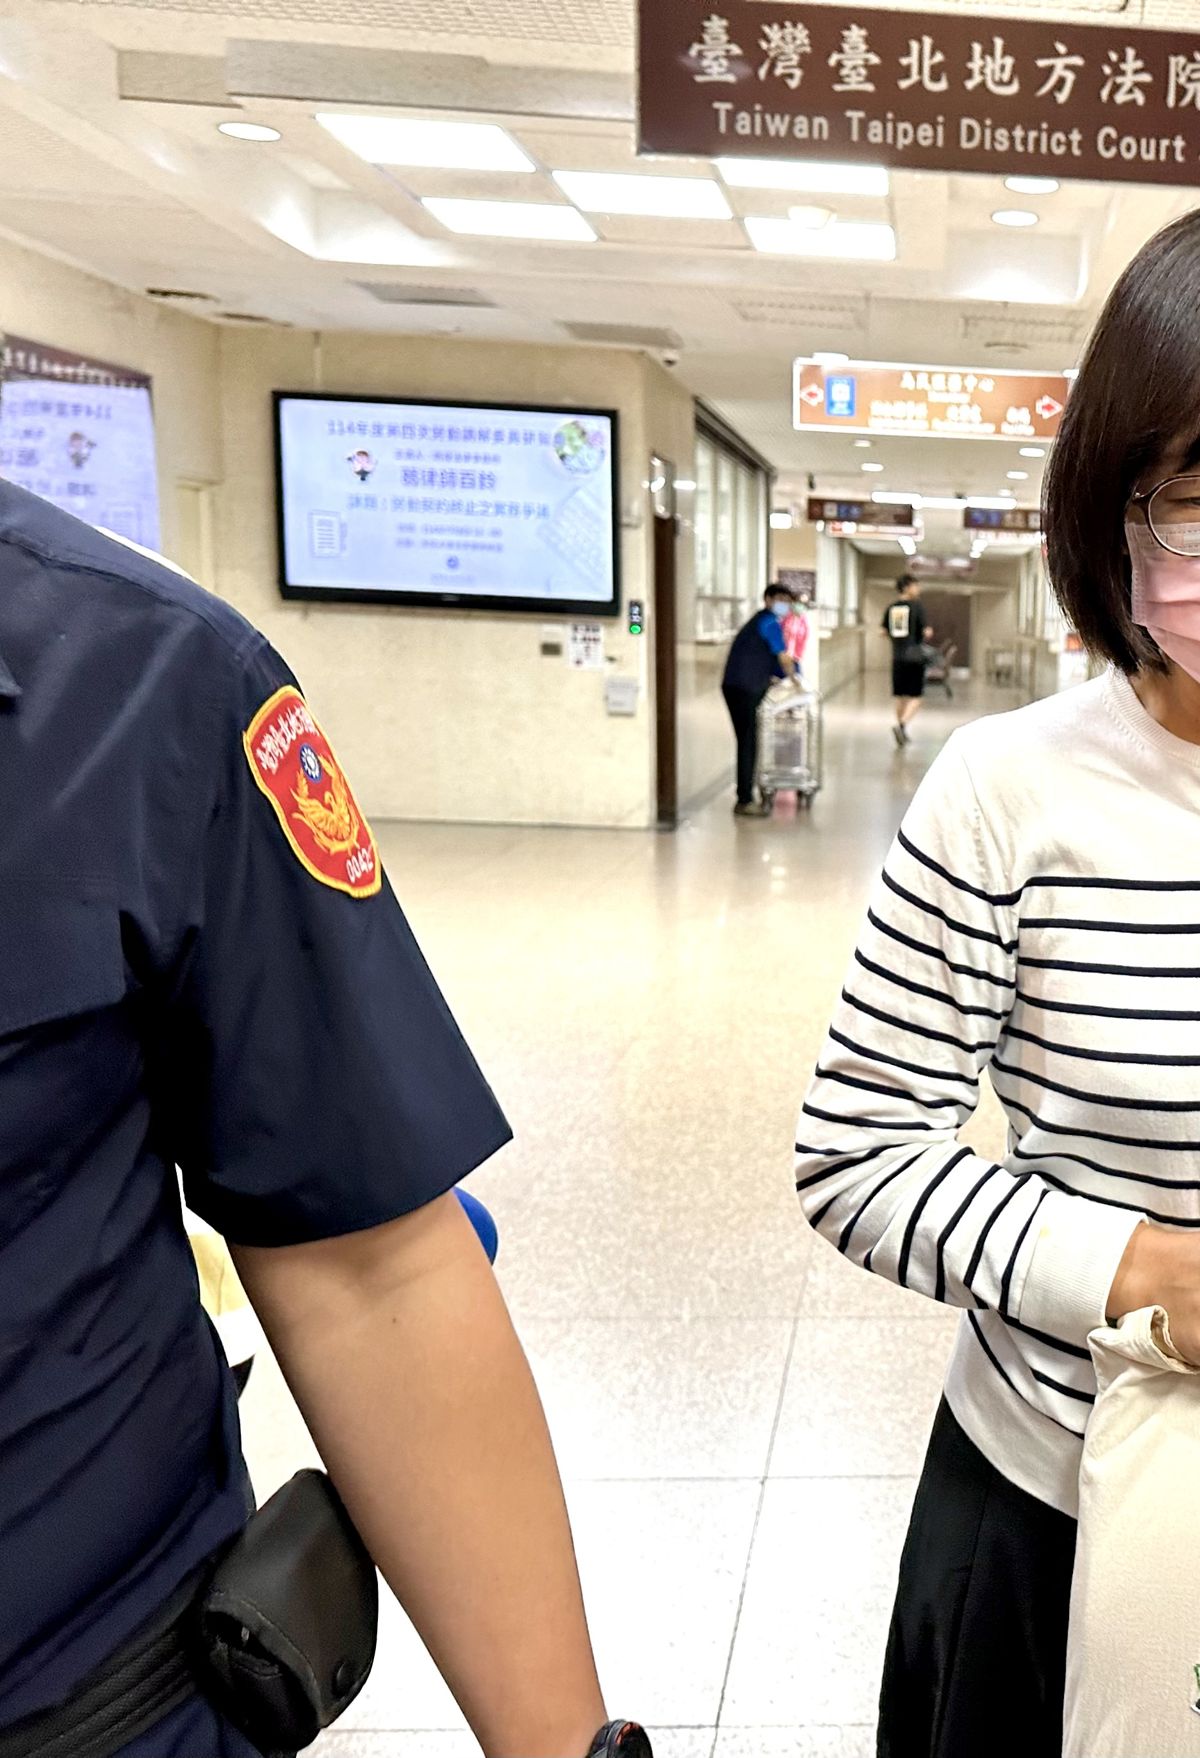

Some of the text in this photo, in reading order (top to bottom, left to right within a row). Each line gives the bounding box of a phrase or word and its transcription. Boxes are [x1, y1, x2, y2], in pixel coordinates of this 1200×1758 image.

[713, 102, 1186, 163] Taiwan Taipei District Court
